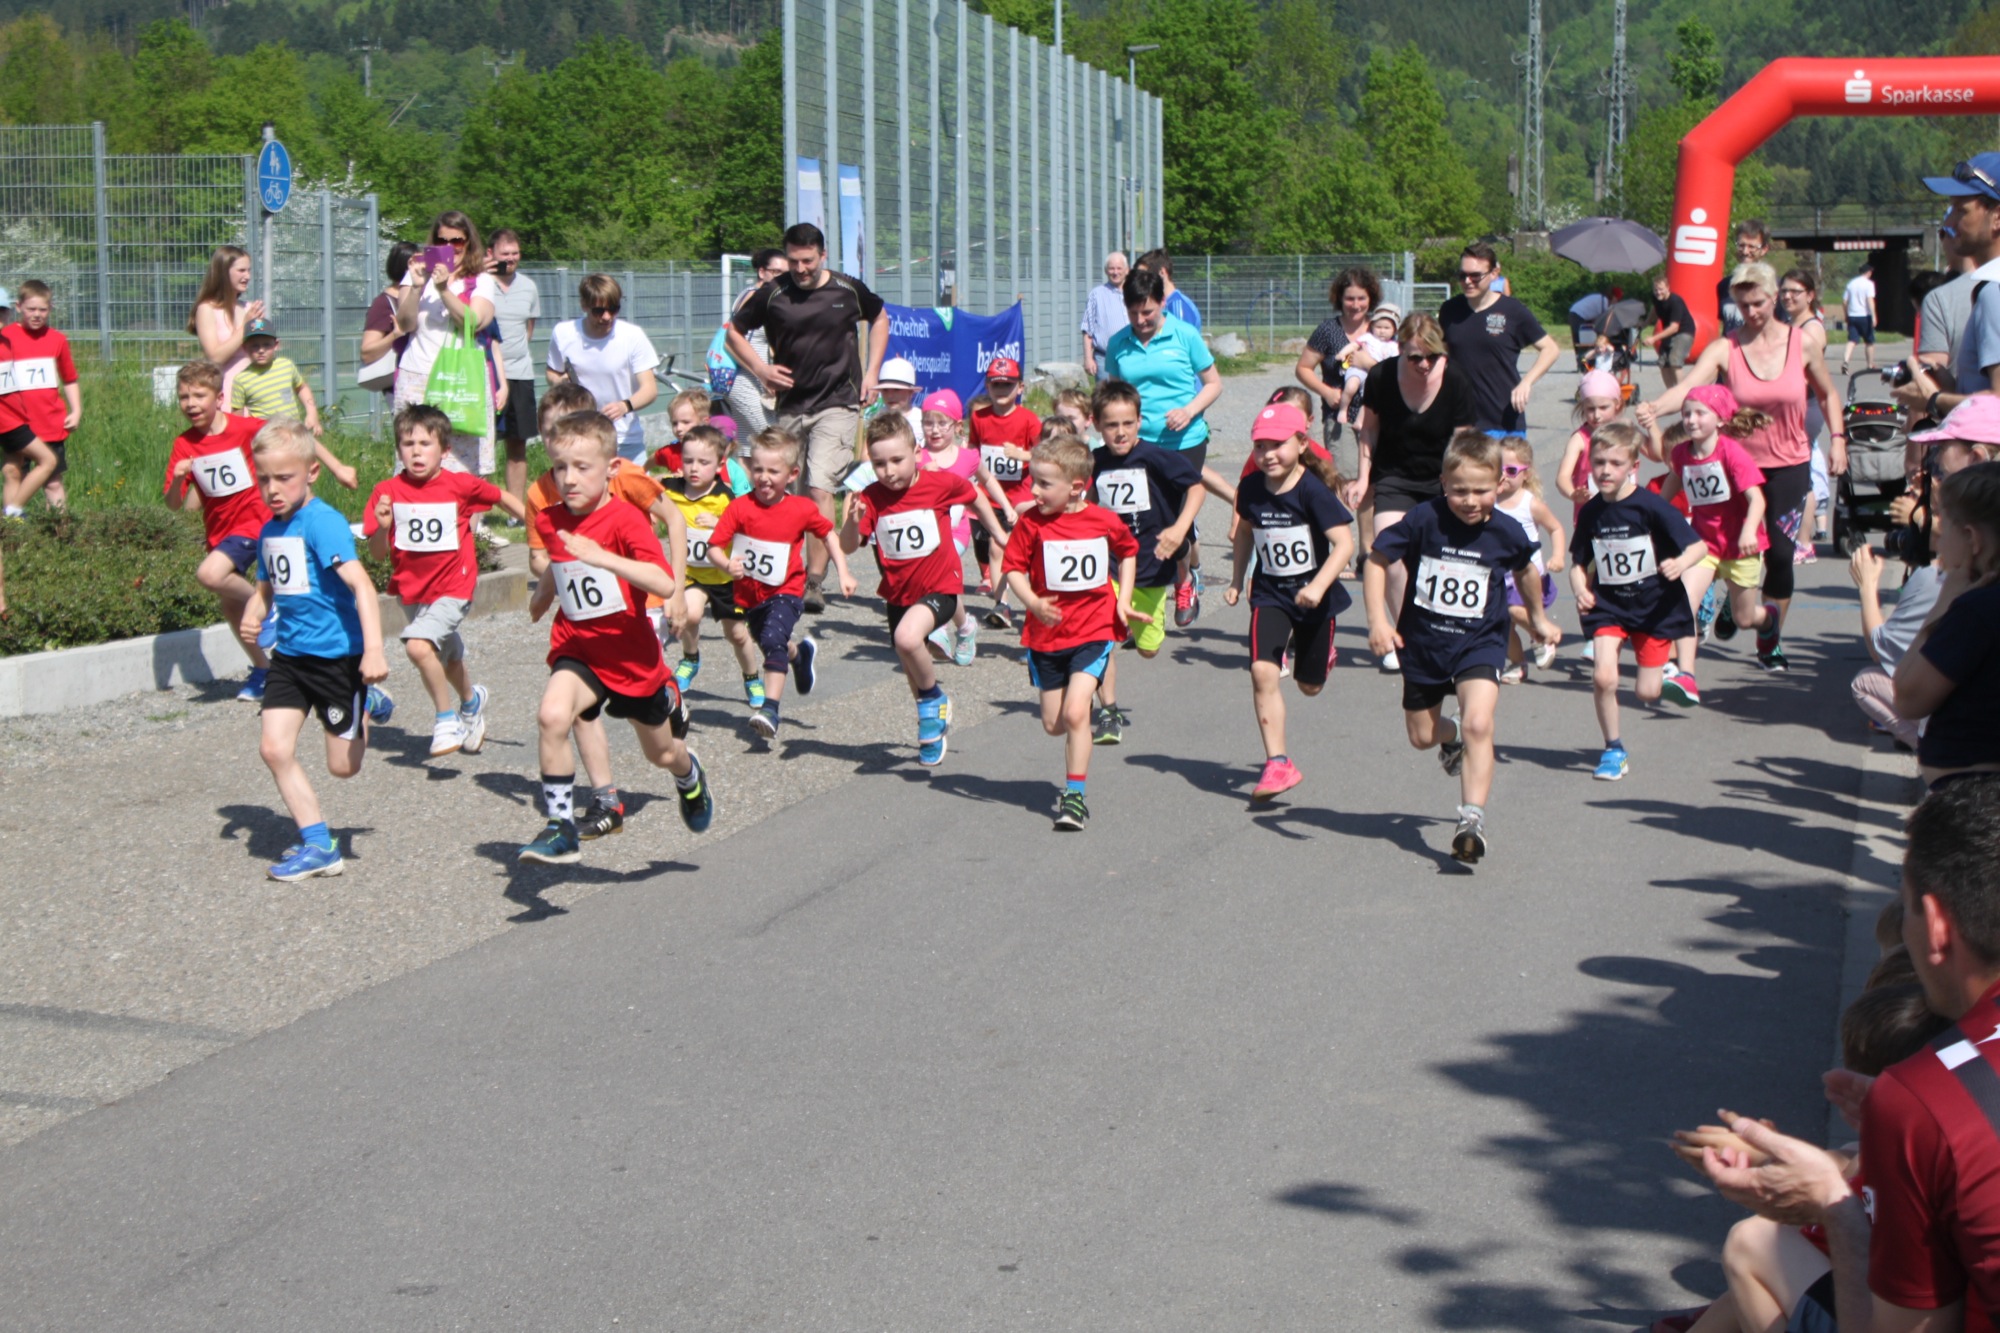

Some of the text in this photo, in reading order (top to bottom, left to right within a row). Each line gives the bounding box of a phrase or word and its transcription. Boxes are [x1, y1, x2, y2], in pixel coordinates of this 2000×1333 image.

[1881, 85, 1974, 106] Sparkasse
[26, 368, 46, 384] 71
[203, 465, 236, 490] 76
[985, 456, 1018, 475] 169
[1107, 483, 1136, 506] 72
[1687, 475, 1724, 499] 132
[408, 518, 443, 543] 89
[888, 525, 925, 552] 79
[743, 549, 774, 576] 35
[1060, 554, 1097, 582] 20
[1261, 541, 1310, 568] 186
[1601, 549, 1646, 577] 187
[268, 554, 291, 585] 49
[566, 576, 603, 610] 16
[1425, 574, 1480, 608] 188
